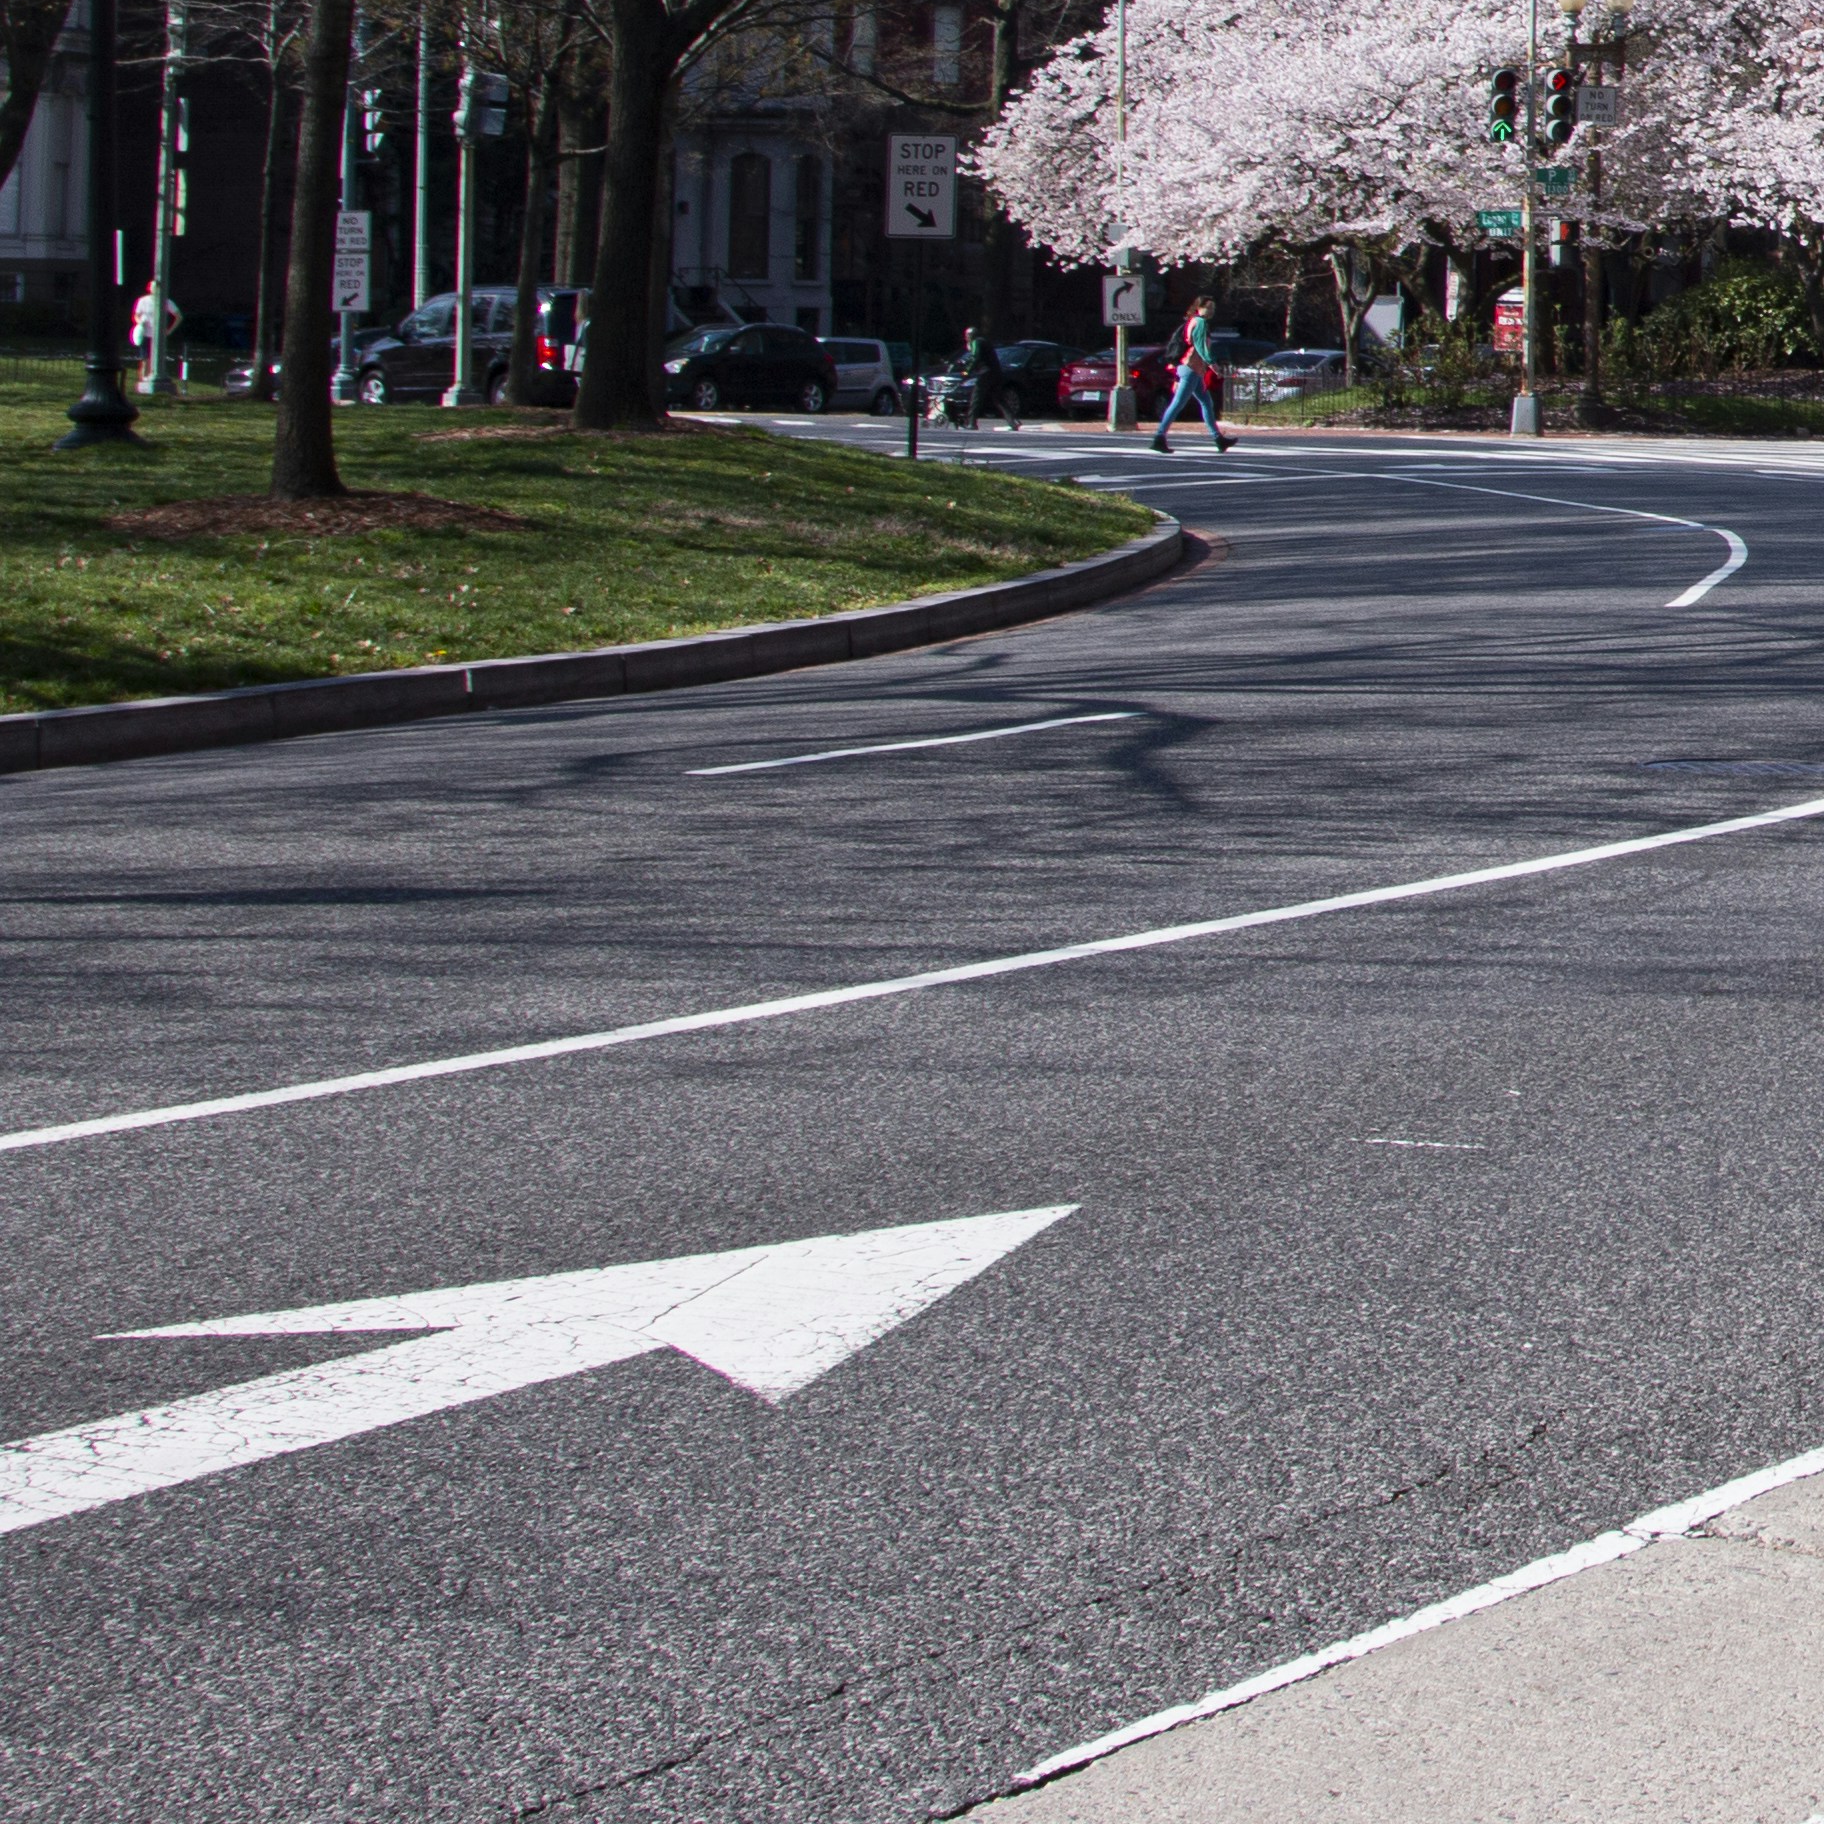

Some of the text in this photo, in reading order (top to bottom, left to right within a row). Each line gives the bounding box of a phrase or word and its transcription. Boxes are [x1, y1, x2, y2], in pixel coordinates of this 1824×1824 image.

[1590, 91, 1604, 99] NO
[1585, 102, 1608, 111] TURN
[1596, 114, 1613, 122] RED
[900, 143, 946, 159] STOP
[898, 165, 947, 175] HERE ON
[1549, 170, 1556, 182] P
[904, 181, 940, 197] RED
[338, 258, 364, 267] STOP
[340, 280, 360, 289] RED
[1112, 313, 1136, 321] ONLY
